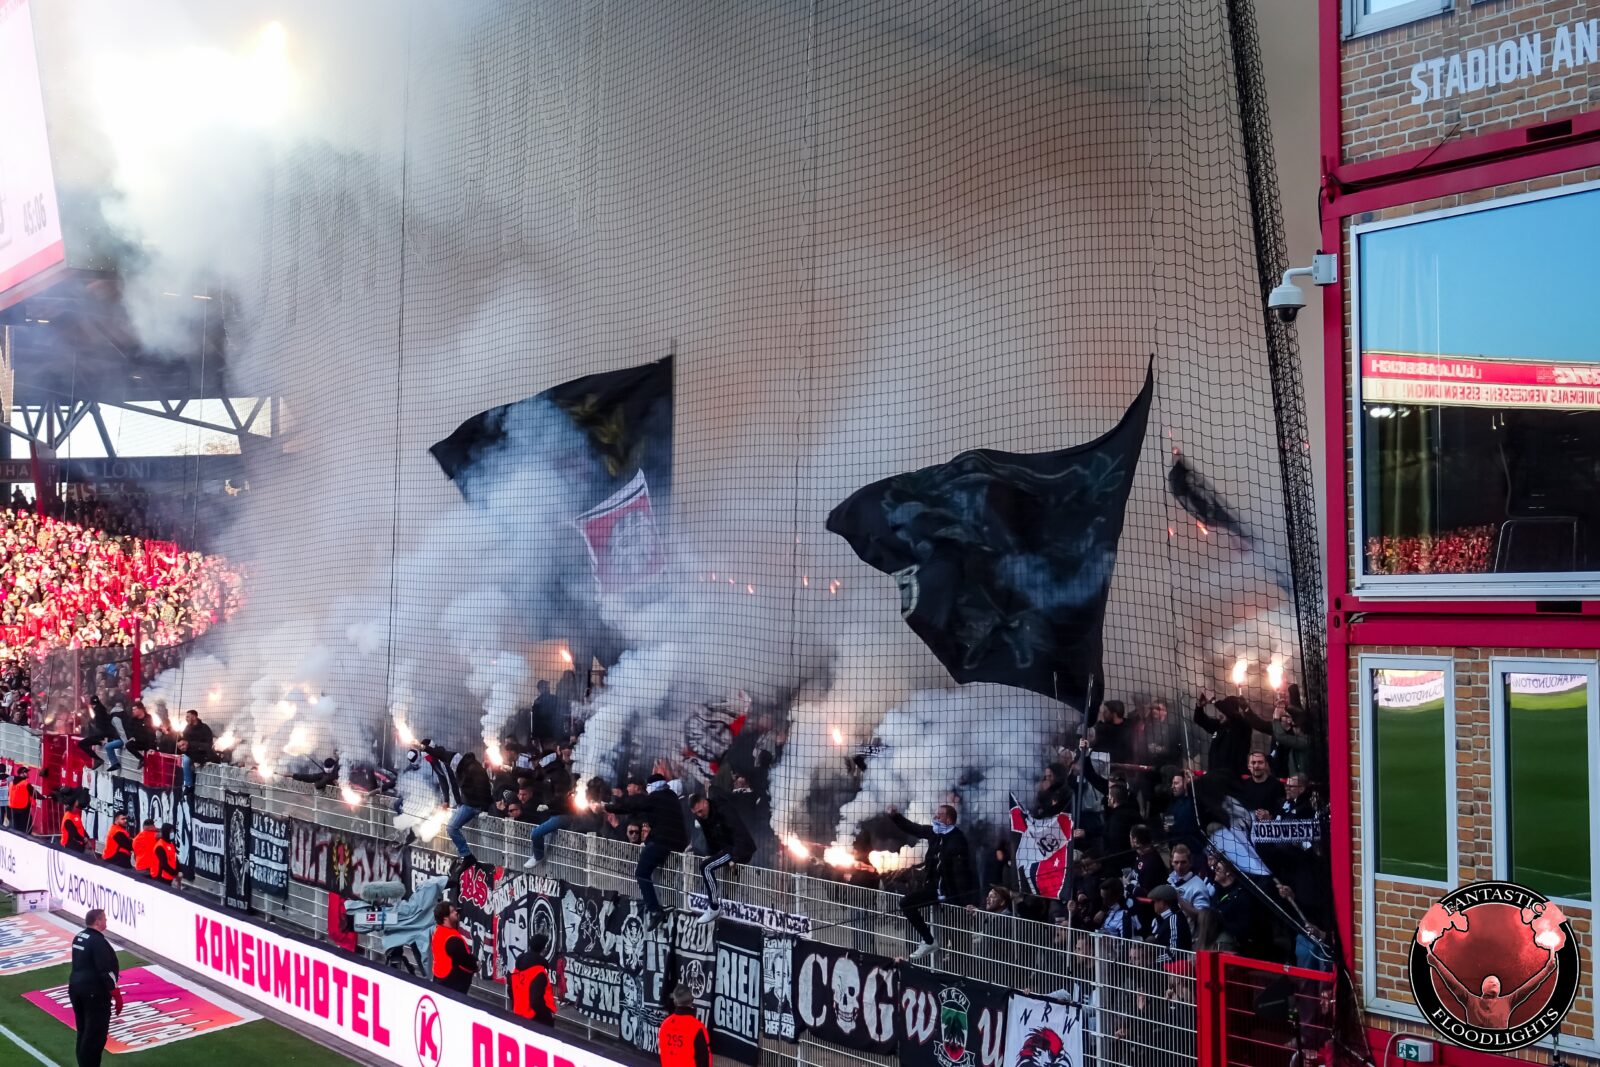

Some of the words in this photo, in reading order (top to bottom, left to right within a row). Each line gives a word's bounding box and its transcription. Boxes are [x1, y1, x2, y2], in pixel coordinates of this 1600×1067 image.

[1411, 32, 1541, 105] STADION
[1552, 18, 1598, 73] AN
[23, 193, 47, 237] 45:06
[252, 812, 286, 838] ULTRAS
[67, 873, 137, 928] AROUNDTOWN
[195, 913, 391, 1047] KONSUMHOTEL
[564, 971, 621, 1015] FFM
[715, 948, 760, 1008] RIED
[714, 995, 760, 1040] GEBIET
